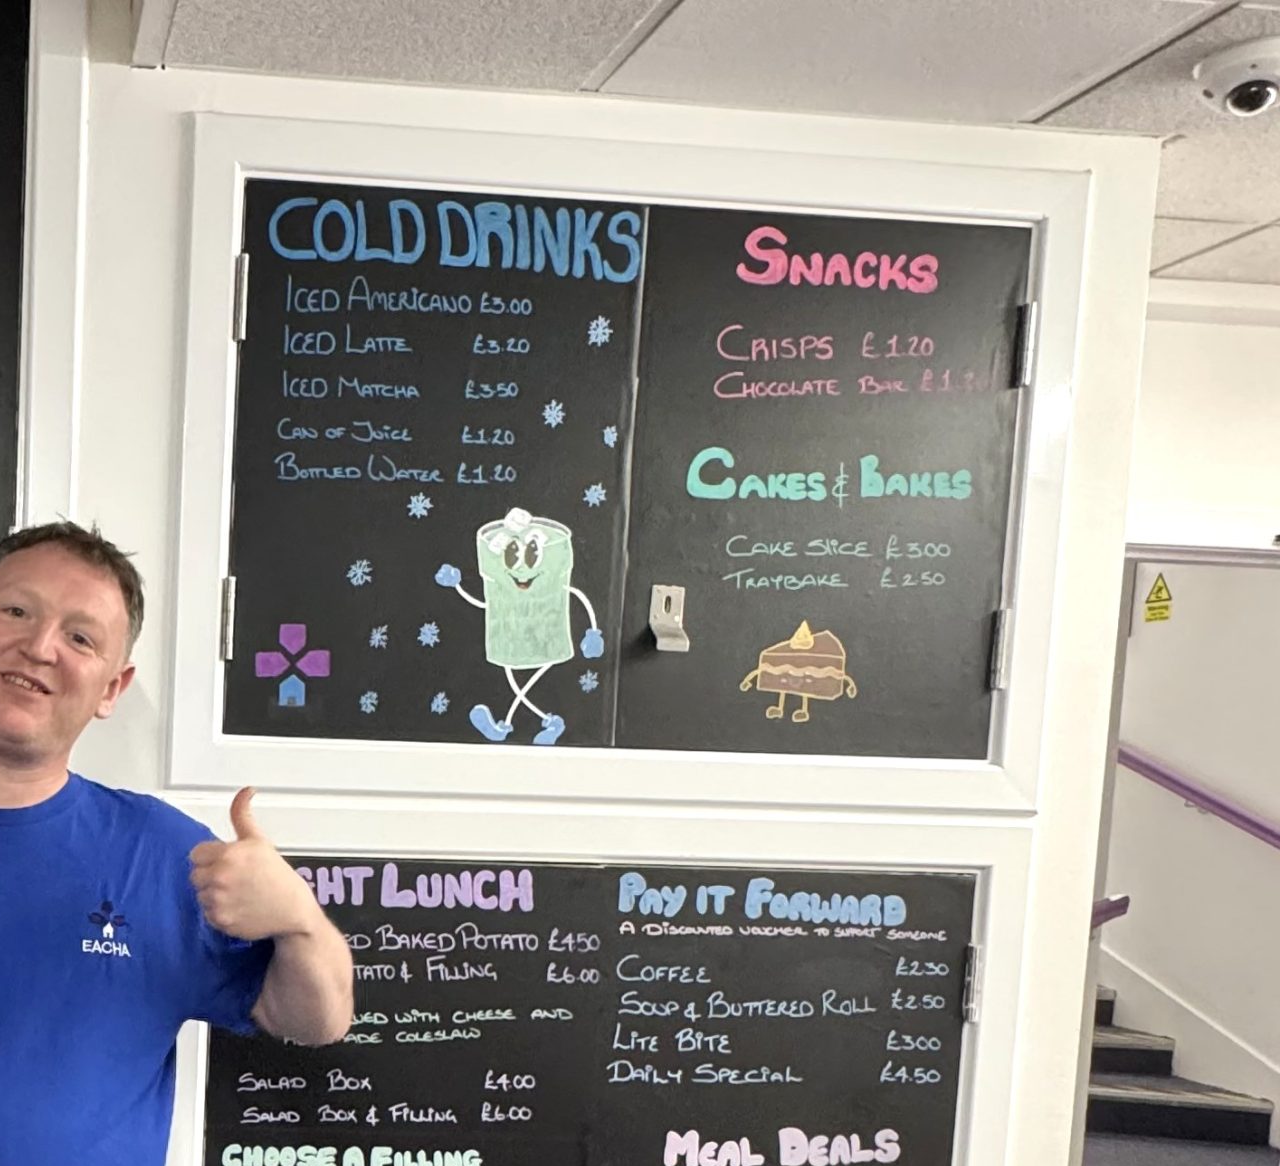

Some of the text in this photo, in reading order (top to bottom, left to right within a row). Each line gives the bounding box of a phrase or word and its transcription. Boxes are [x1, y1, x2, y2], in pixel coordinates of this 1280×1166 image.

[269, 198, 643, 285] COLD DRINKS
[81, 938, 132, 957] EACHA
